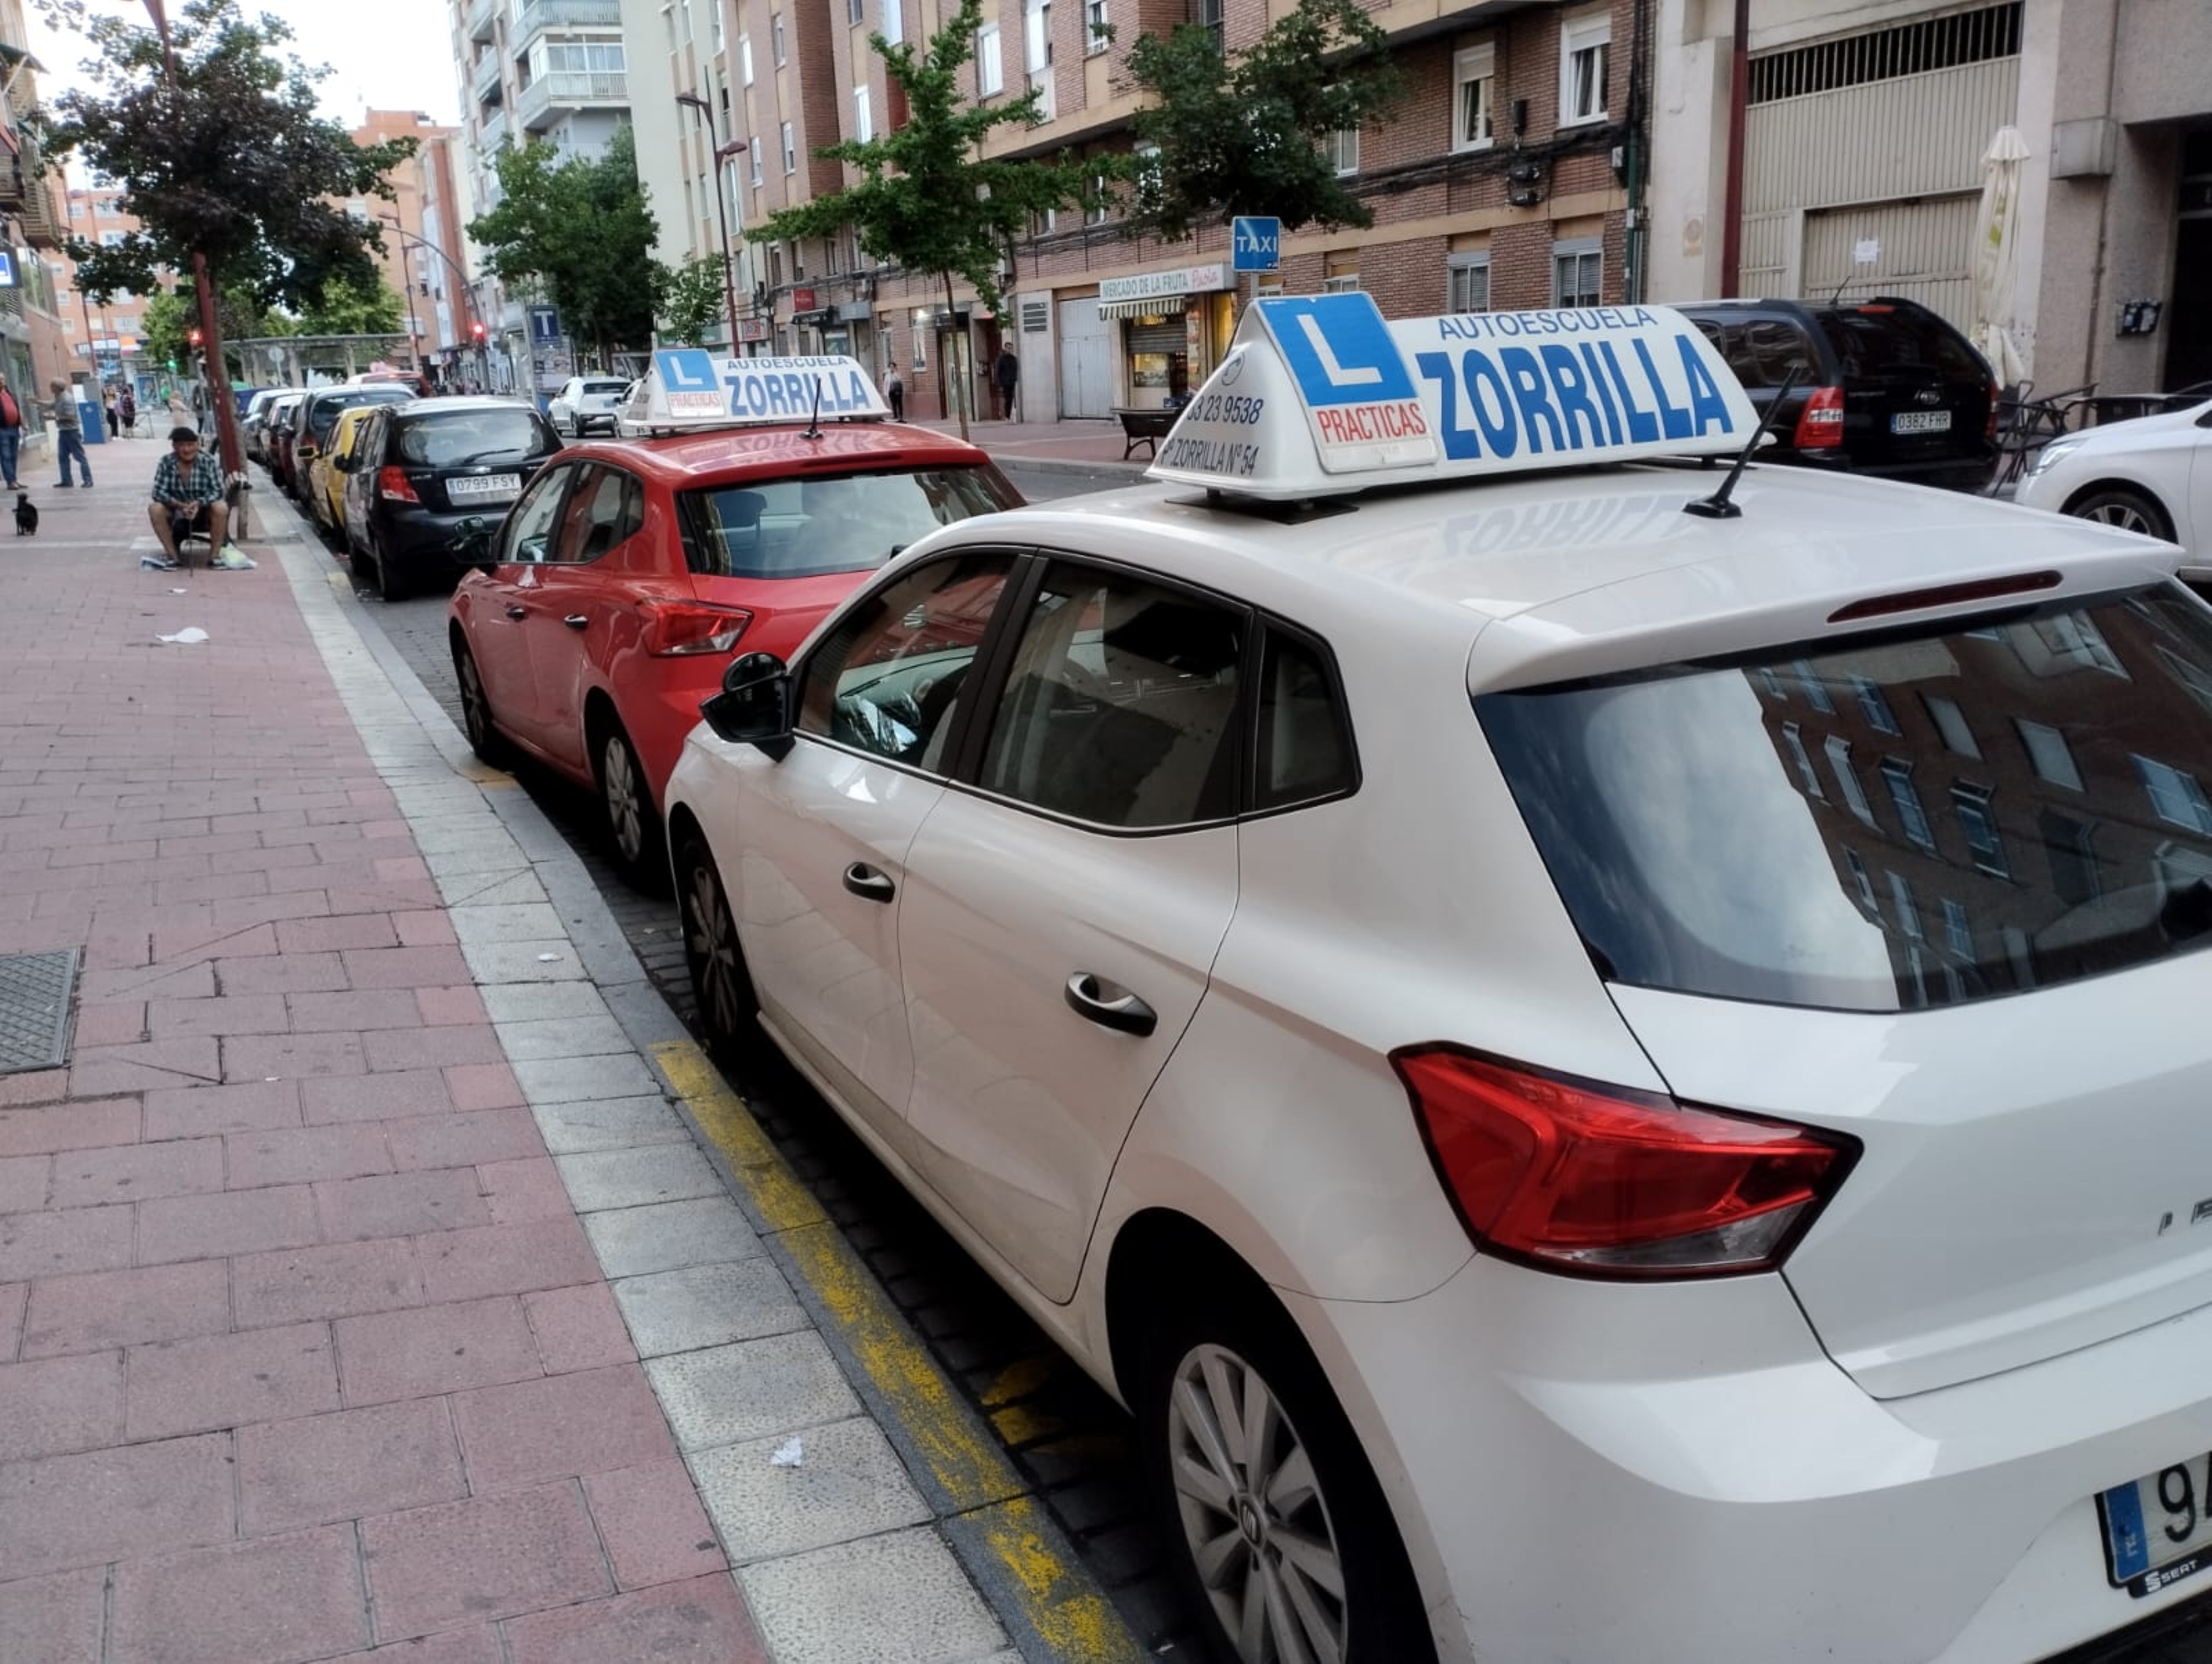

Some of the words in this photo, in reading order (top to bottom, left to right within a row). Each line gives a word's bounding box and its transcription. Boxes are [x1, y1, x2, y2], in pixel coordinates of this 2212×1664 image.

[1236, 236, 1277, 253] TAXI
[1102, 279, 1138, 298] MERCADO
[1140, 278, 1149, 294] DE
[1151, 276, 1160, 292] LA
[1163, 272, 1188, 291] FRUTA
[534, 310, 553, 335] T
[1438, 307, 1658, 341] AUTOESCUELA
[727, 357, 848, 370] AUTOESCUELA
[1296, 313, 1383, 387] L
[670, 356, 703, 385] L
[723, 371, 872, 416] ZORRILLA
[1415, 334, 1734, 461] ZORRILLA
[1204, 395, 1222, 422] 23
[1223, 396, 1264, 424] 9538
[1316, 402, 1427, 444] PRACTICAS
[1899, 414, 1926, 428] 0382
[1241, 444, 1260, 476] 54
[457, 478, 489, 491] 0799
[492, 474, 517, 488] FSY
